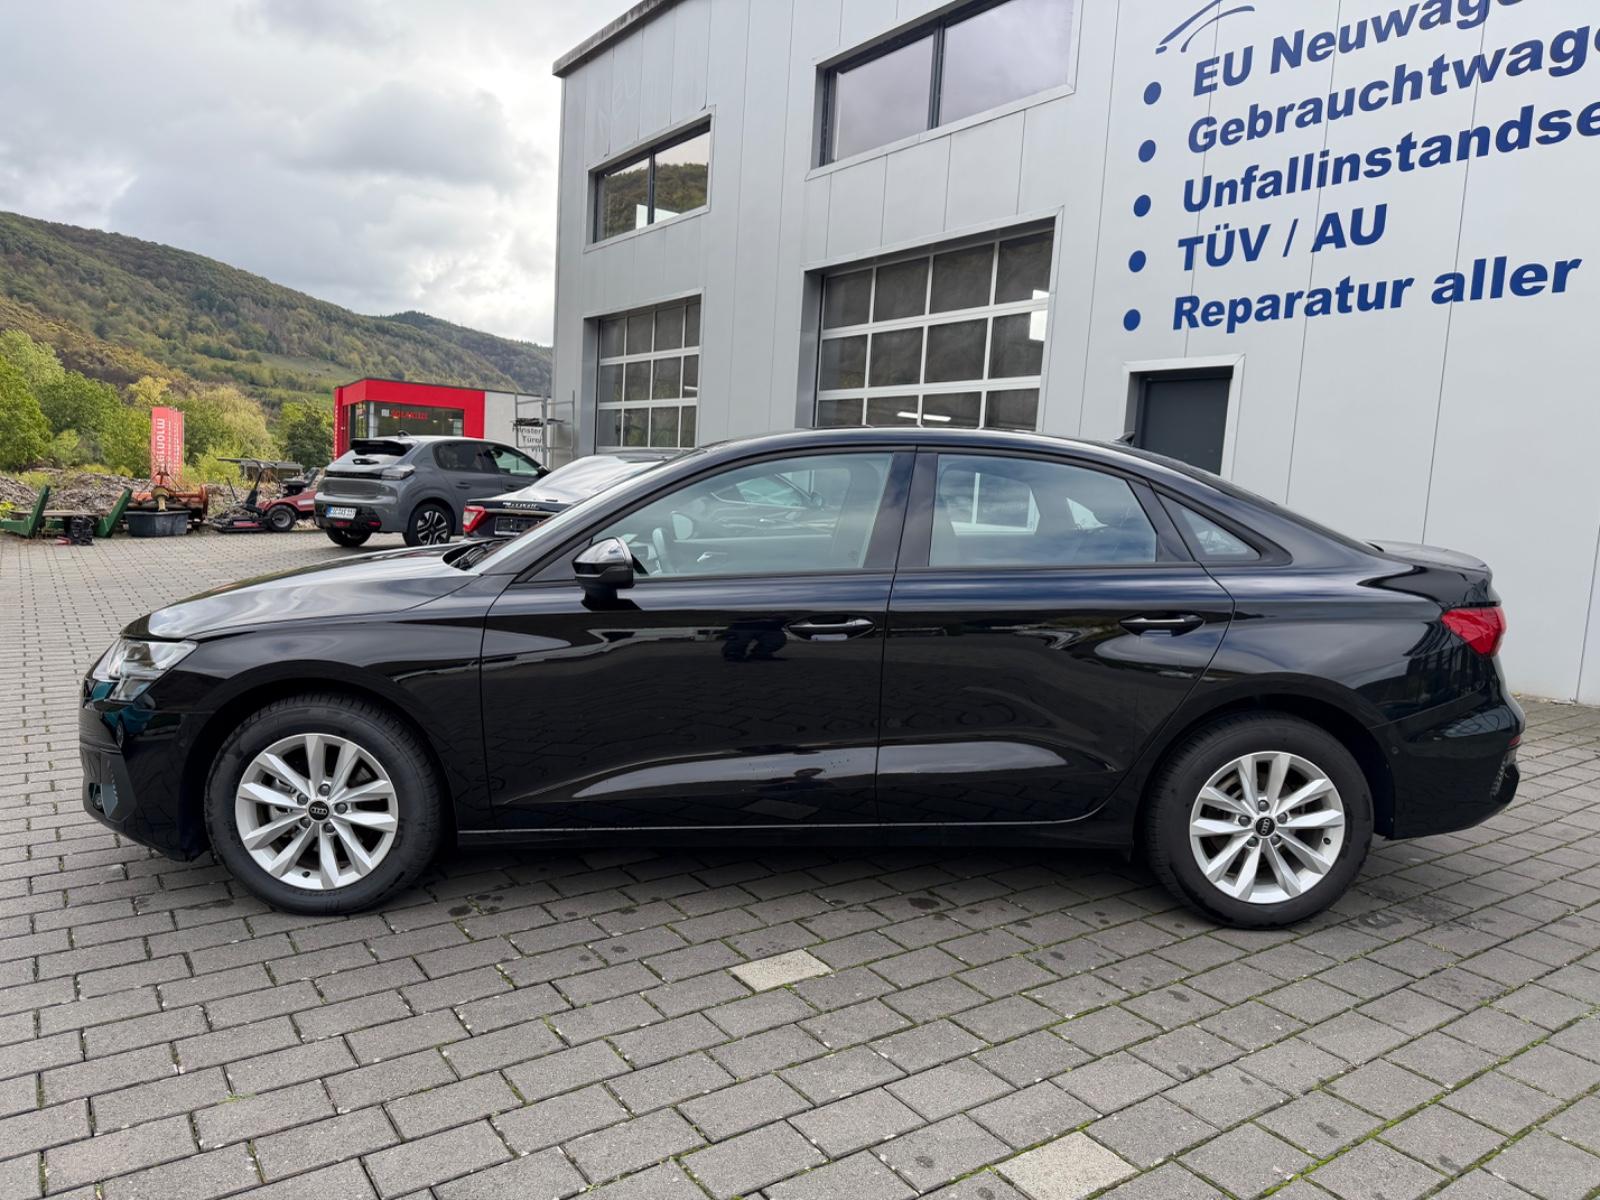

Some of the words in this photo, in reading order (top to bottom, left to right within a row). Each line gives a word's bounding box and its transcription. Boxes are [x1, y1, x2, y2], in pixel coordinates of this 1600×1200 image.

[1187, 25, 1600, 154] Gebrauchtwag
[1193, 45, 1254, 97] EU
[1270, 0, 1524, 74] Neuwag
[1177, 223, 1271, 272] TÜV
[1283, 219, 1298, 257] /
[1310, 203, 1388, 253] AU
[1172, 276, 1415, 334] Reparatur
[1430, 256, 1583, 305] aller
